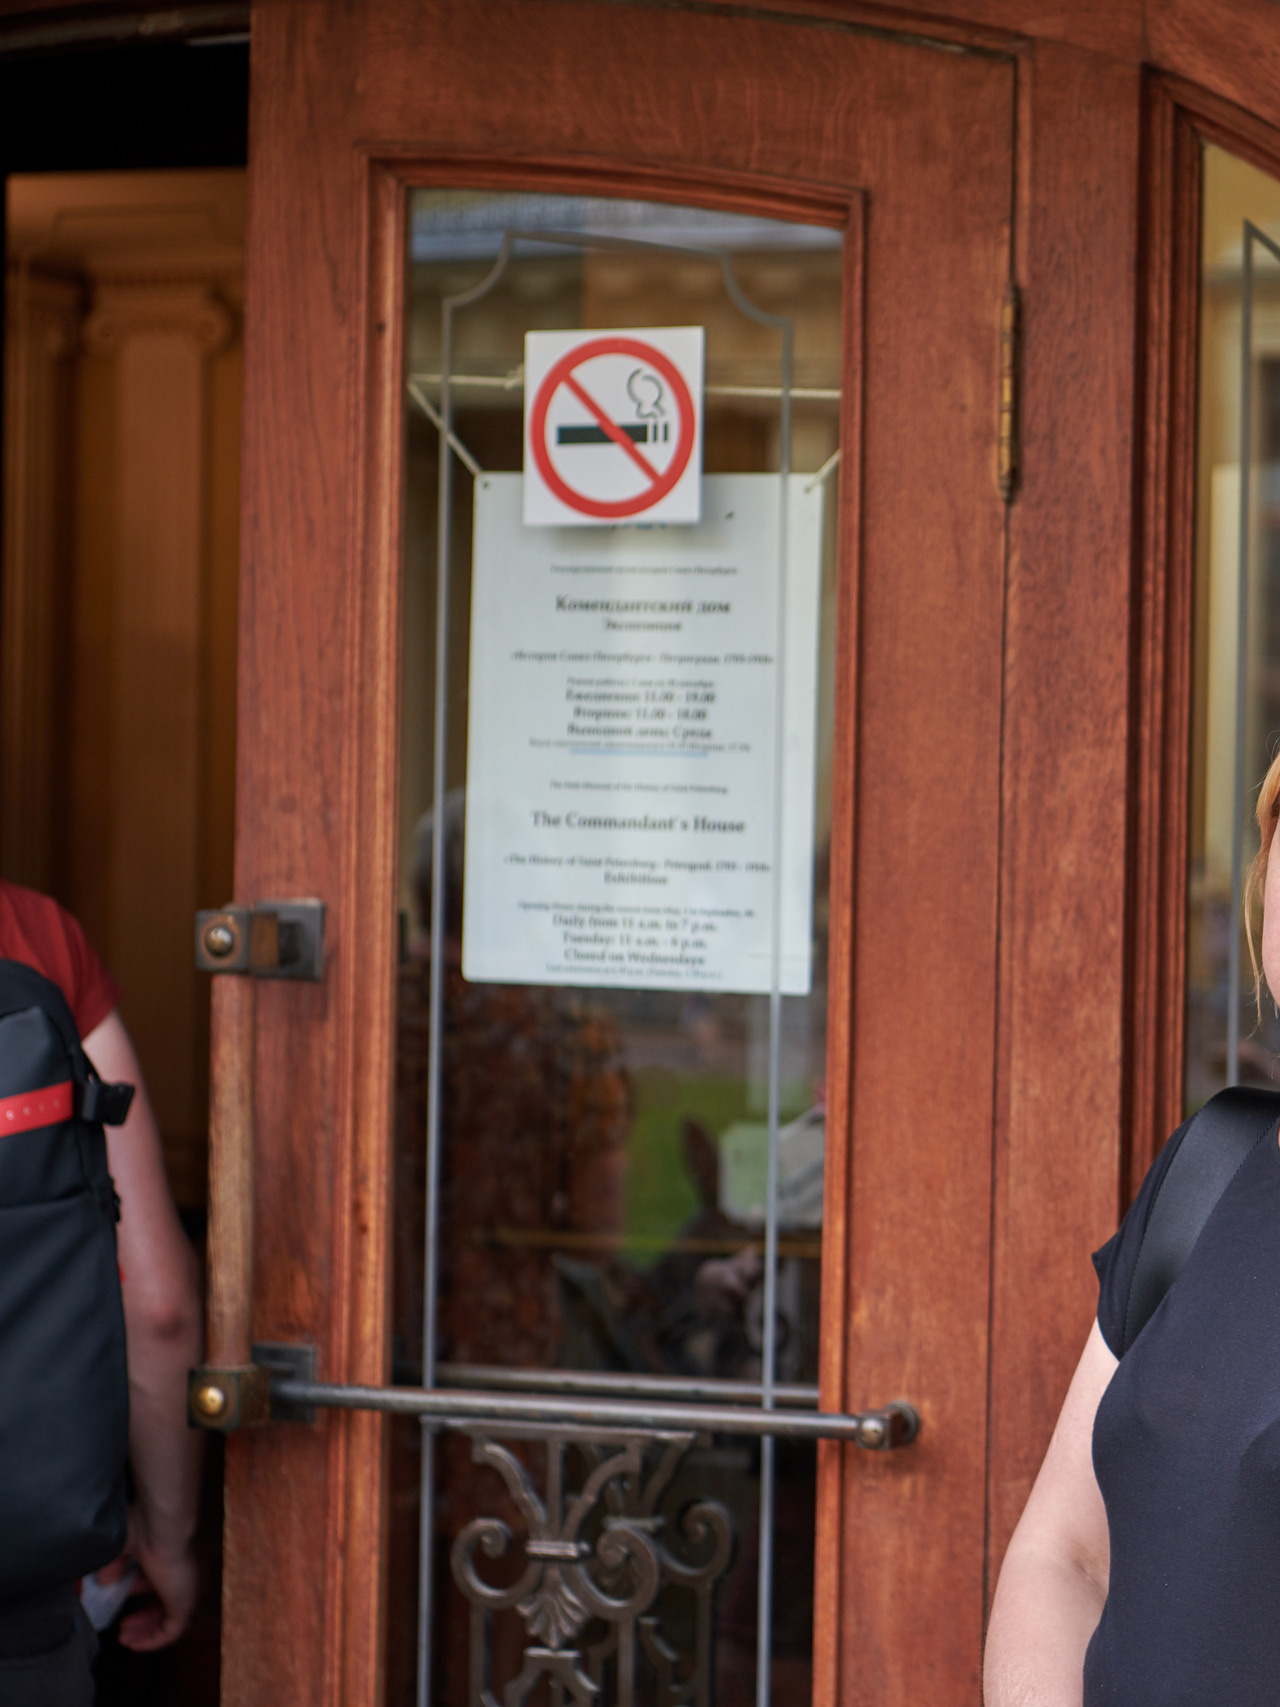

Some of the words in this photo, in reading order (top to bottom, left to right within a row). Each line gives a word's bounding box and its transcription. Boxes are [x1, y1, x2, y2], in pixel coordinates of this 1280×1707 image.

[555, 593, 692, 614] Комендантский
[695, 600, 731, 616] дом
[644, 689, 675, 703] 11.00
[635, 706, 666, 720] 11.00
[530, 808, 561, 828] The
[693, 814, 745, 833] House
[603, 871, 668, 887] Exhibition
[552, 913, 585, 930] Daily
[588, 914, 618, 929] from
[622, 916, 633, 929] 11
[664, 918, 678, 930] to
[681, 918, 689, 931] 7
[562, 930, 615, 947] Tuesday:
[619, 933, 632, 946] 11
[563, 947, 605, 961] Closed
[607, 950, 624, 962] on
[627, 951, 706, 968] Wednesdays
